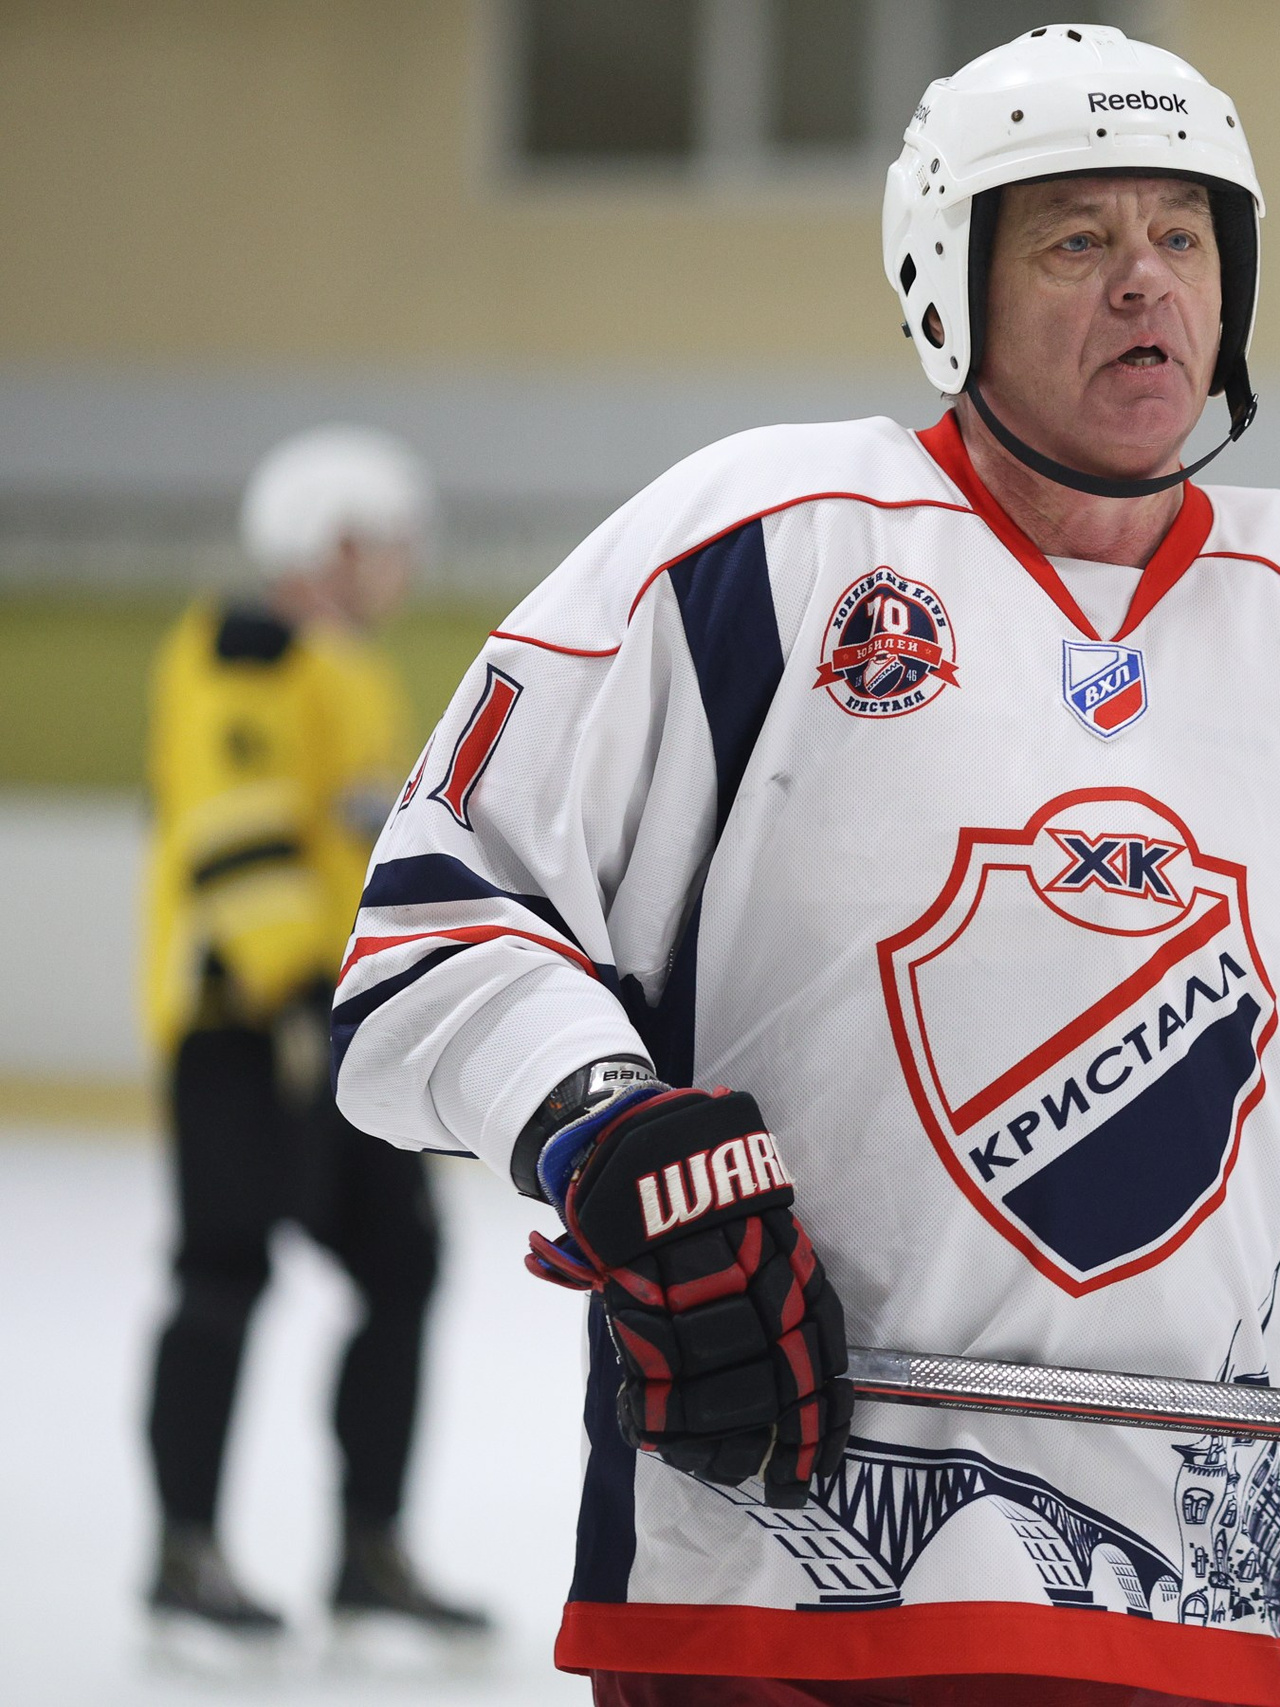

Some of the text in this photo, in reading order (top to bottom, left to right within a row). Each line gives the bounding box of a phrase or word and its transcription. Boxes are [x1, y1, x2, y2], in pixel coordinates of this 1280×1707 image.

[1088, 90, 1189, 115] Reebok
[912, 587, 947, 628] КЛУБ
[856, 638, 919, 659] ЮБИЛЕЙ
[906, 669, 918, 682] 46
[1085, 664, 1131, 708] ВХЛ
[845, 690, 926, 713] КРИСТАЛЛ
[392, 662, 524, 832] 1
[1048, 831, 1181, 904] ХК
[968, 951, 1248, 1183] КРИСТАЛЛ
[1102, 1417, 1138, 1425] CARBON
[1169, 1423, 1205, 1431] CARBON
